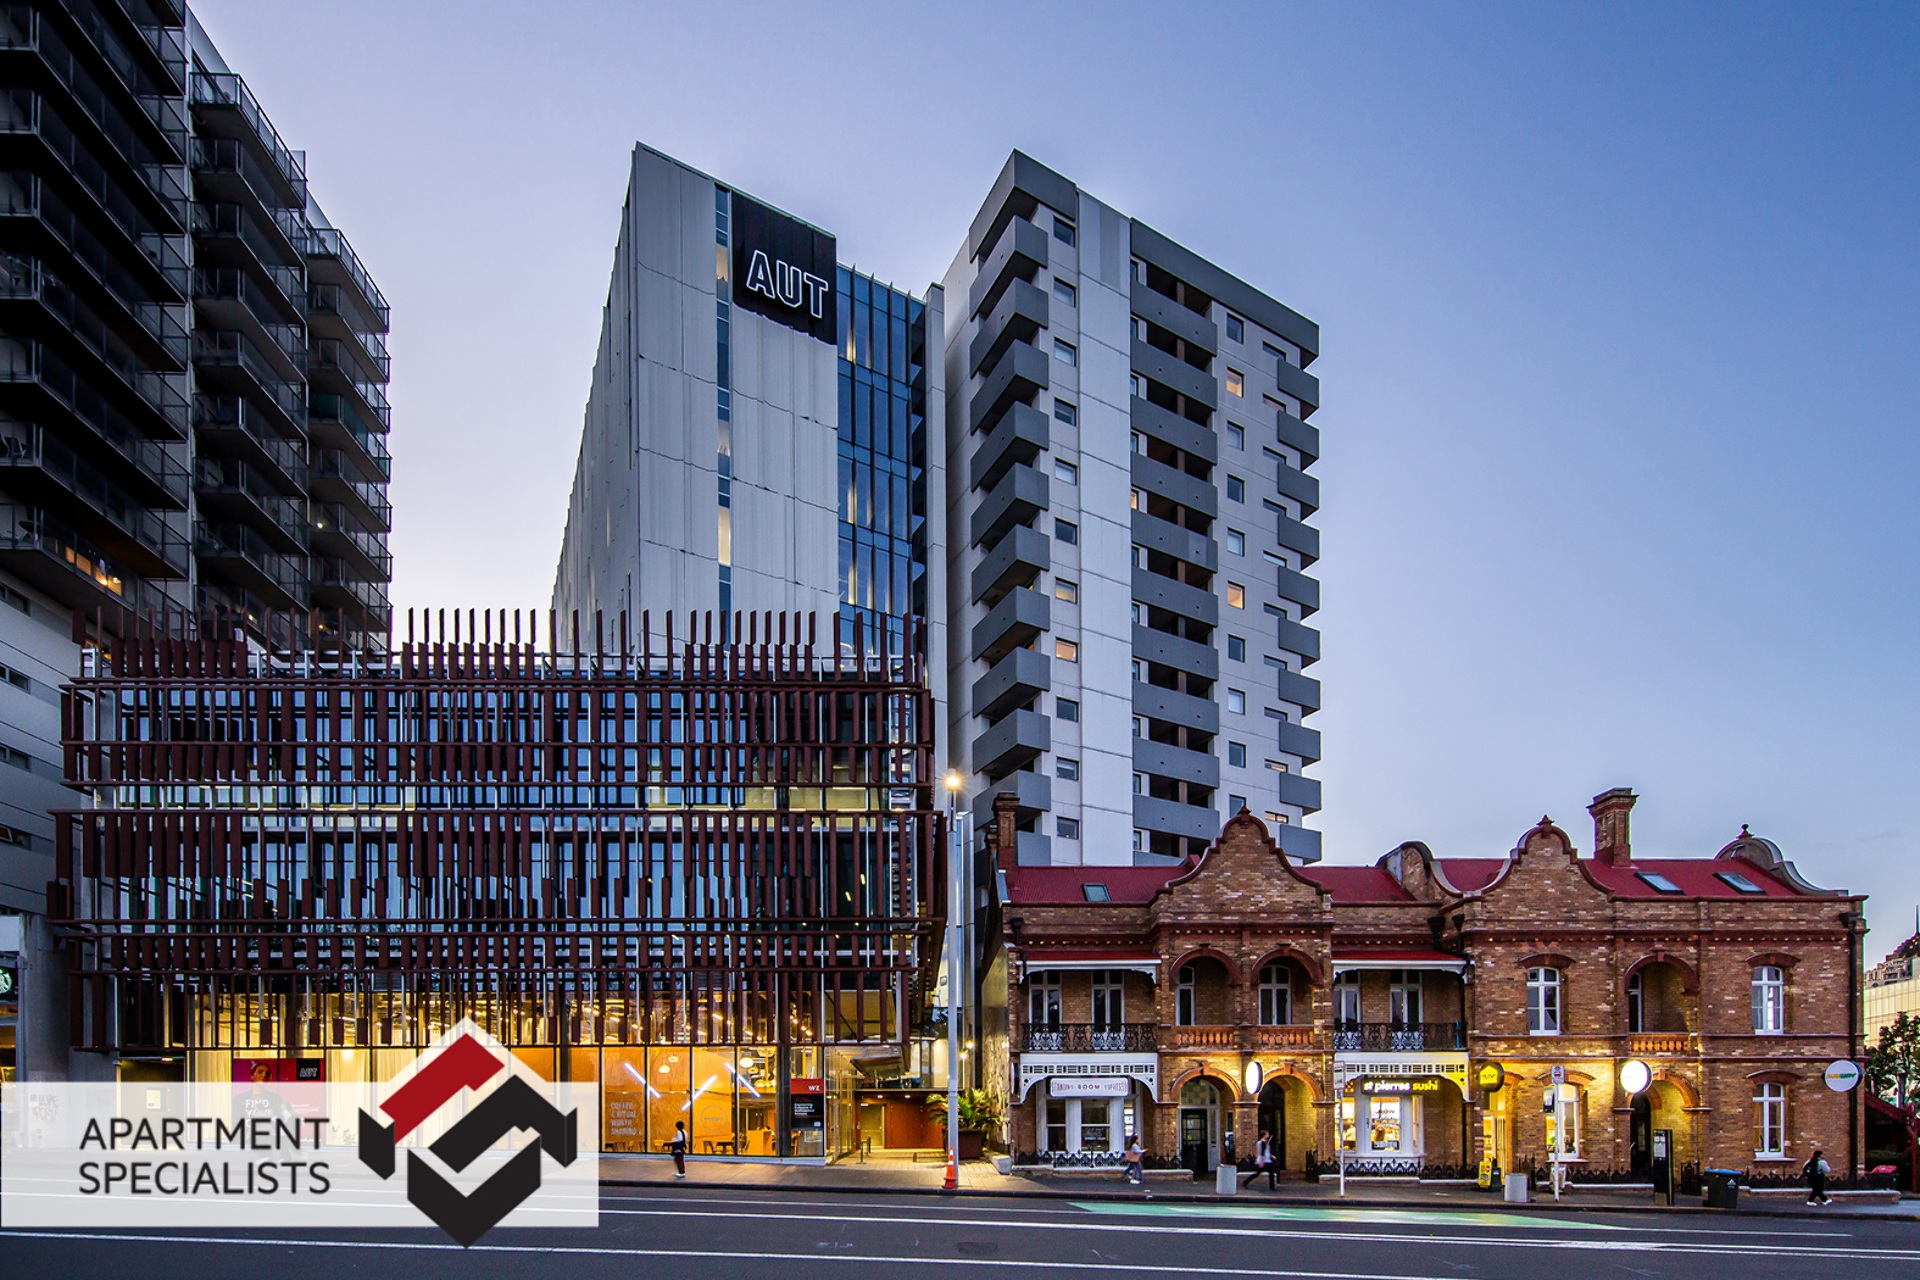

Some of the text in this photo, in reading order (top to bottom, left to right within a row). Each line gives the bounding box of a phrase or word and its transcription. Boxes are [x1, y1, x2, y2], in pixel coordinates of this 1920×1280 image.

[746, 249, 829, 319] AUT
[299, 1067, 318, 1078] AUT
[1412, 1080, 1438, 1091] sushi
